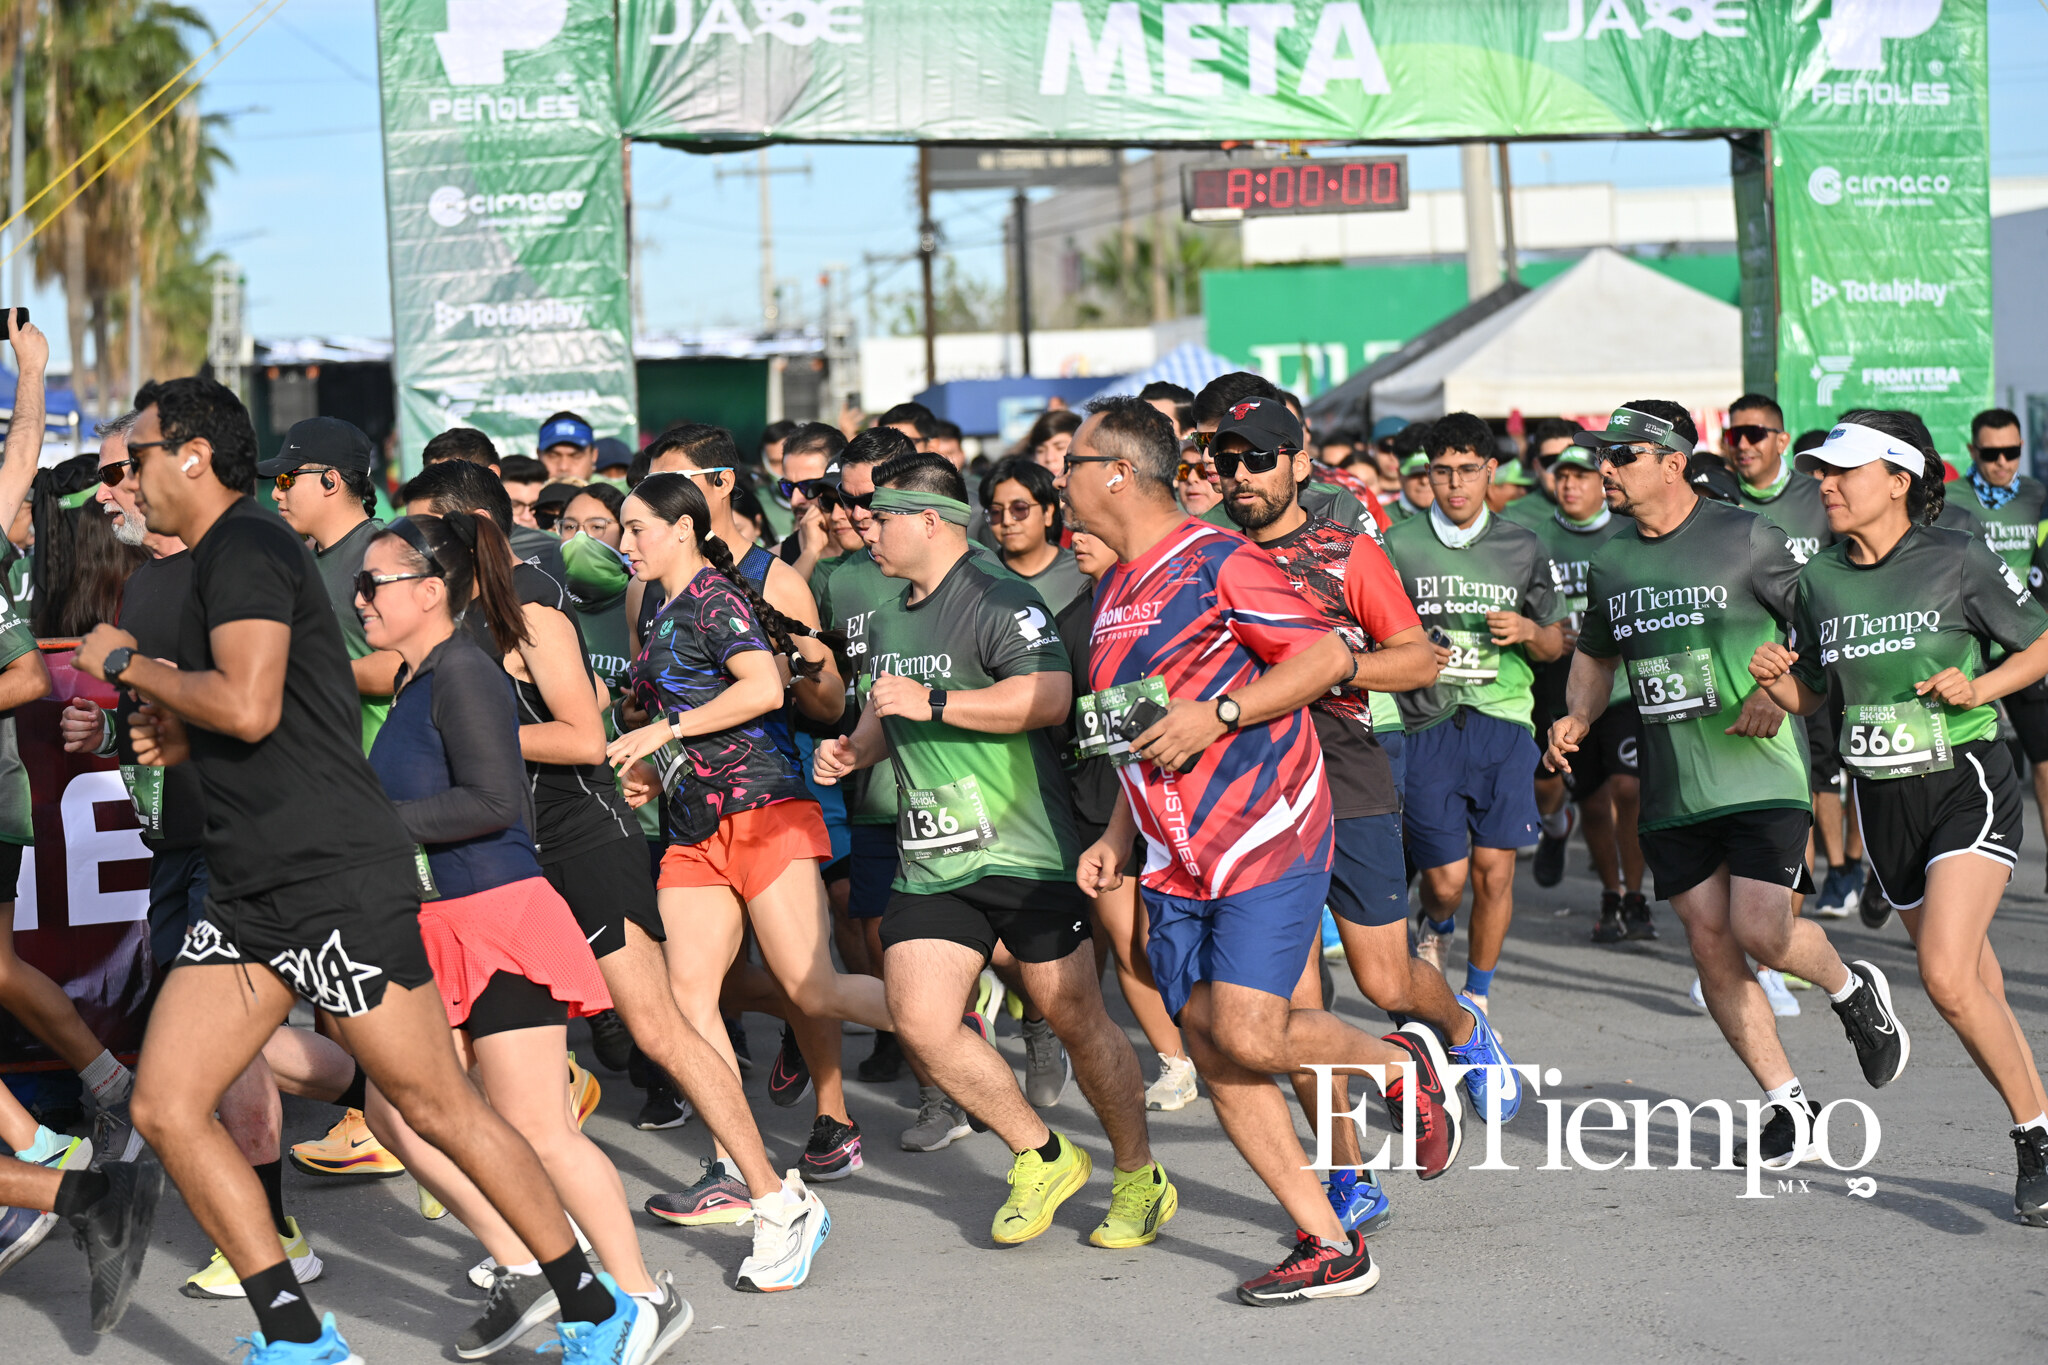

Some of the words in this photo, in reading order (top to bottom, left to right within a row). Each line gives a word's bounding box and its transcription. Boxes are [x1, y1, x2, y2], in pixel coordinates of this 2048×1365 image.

[1039, 2, 1391, 95] META
[1840, 277, 1948, 307] Totalplay
[471, 300, 585, 329] Totalplay
[1861, 367, 1961, 386] FRONTERA
[1415, 576, 1439, 599] El
[1441, 575, 1518, 605] Tiempo
[1607, 592, 1627, 622] El
[1630, 585, 1728, 614] Tiempo
[1417, 601, 1442, 615] de
[1444, 600, 1501, 614] todos
[846, 613, 865, 639] El
[1107, 628, 1149, 641] FRONTERA
[1613, 625, 1632, 641] de
[1634, 612, 1705, 633] todos
[1820, 617, 1838, 645] El
[1842, 610, 1941, 641] Tiempo
[846, 641, 867, 657] de
[1820, 648, 1839, 667] de
[1842, 637, 1916, 659] todos
[881, 653, 952, 680] Tiempo
[1638, 673, 1687, 704] 133
[1701, 664, 1717, 707] MEDALLA
[1851, 723, 1915, 756] 566
[1931, 713, 1947, 761] MEDALLA
[151, 781, 161, 830] MEDALLA
[970, 791, 993, 839] MEDALLA
[907, 807, 959, 839] 136
